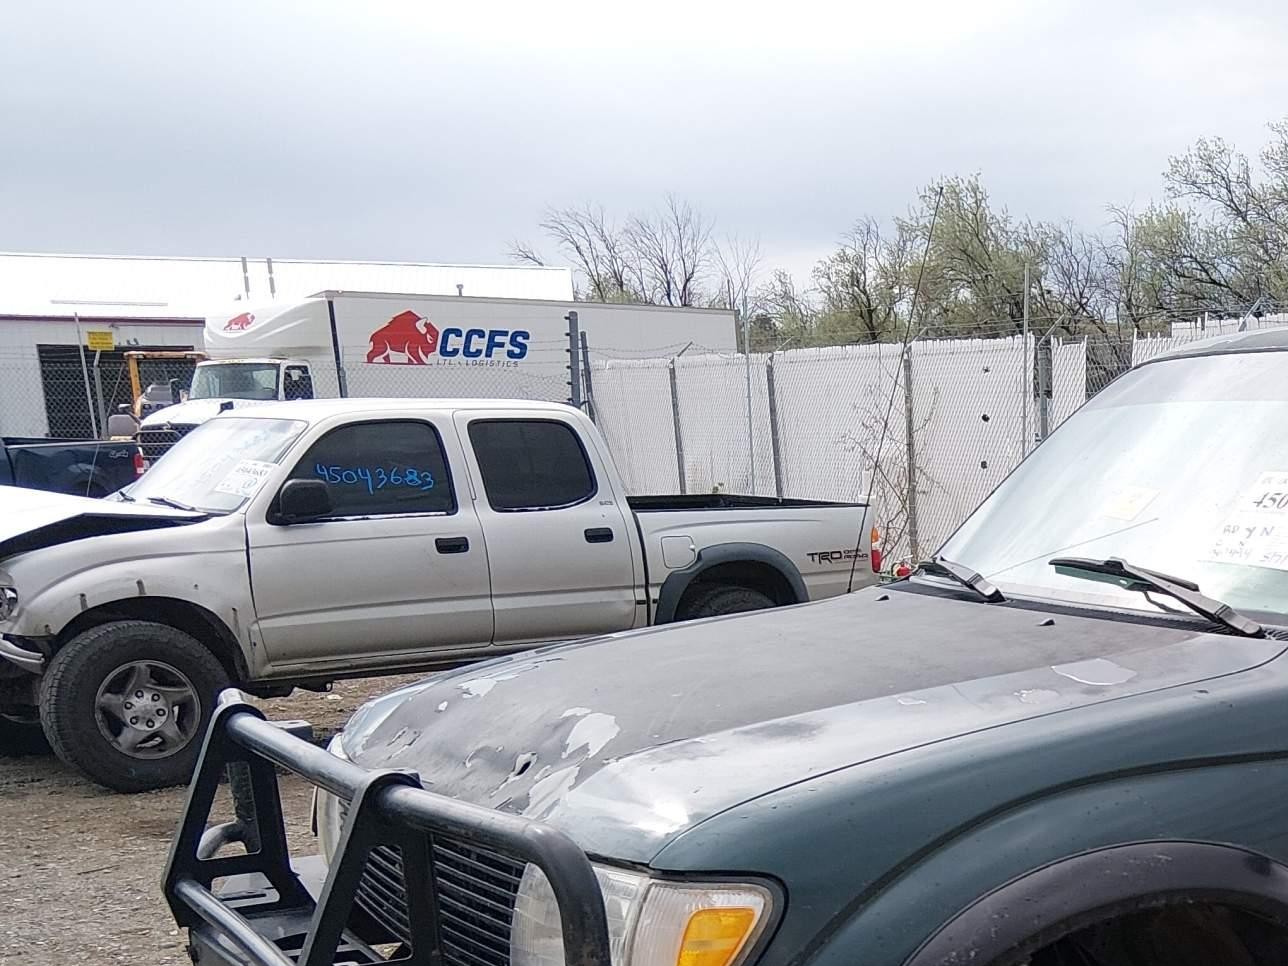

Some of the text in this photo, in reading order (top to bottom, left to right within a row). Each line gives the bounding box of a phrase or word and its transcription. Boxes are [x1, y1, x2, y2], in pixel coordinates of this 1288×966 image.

[439, 327, 530, 360] CCFS
[465, 359, 519, 368] LOGISTICS
[314, 463, 434, 495] 45043683
